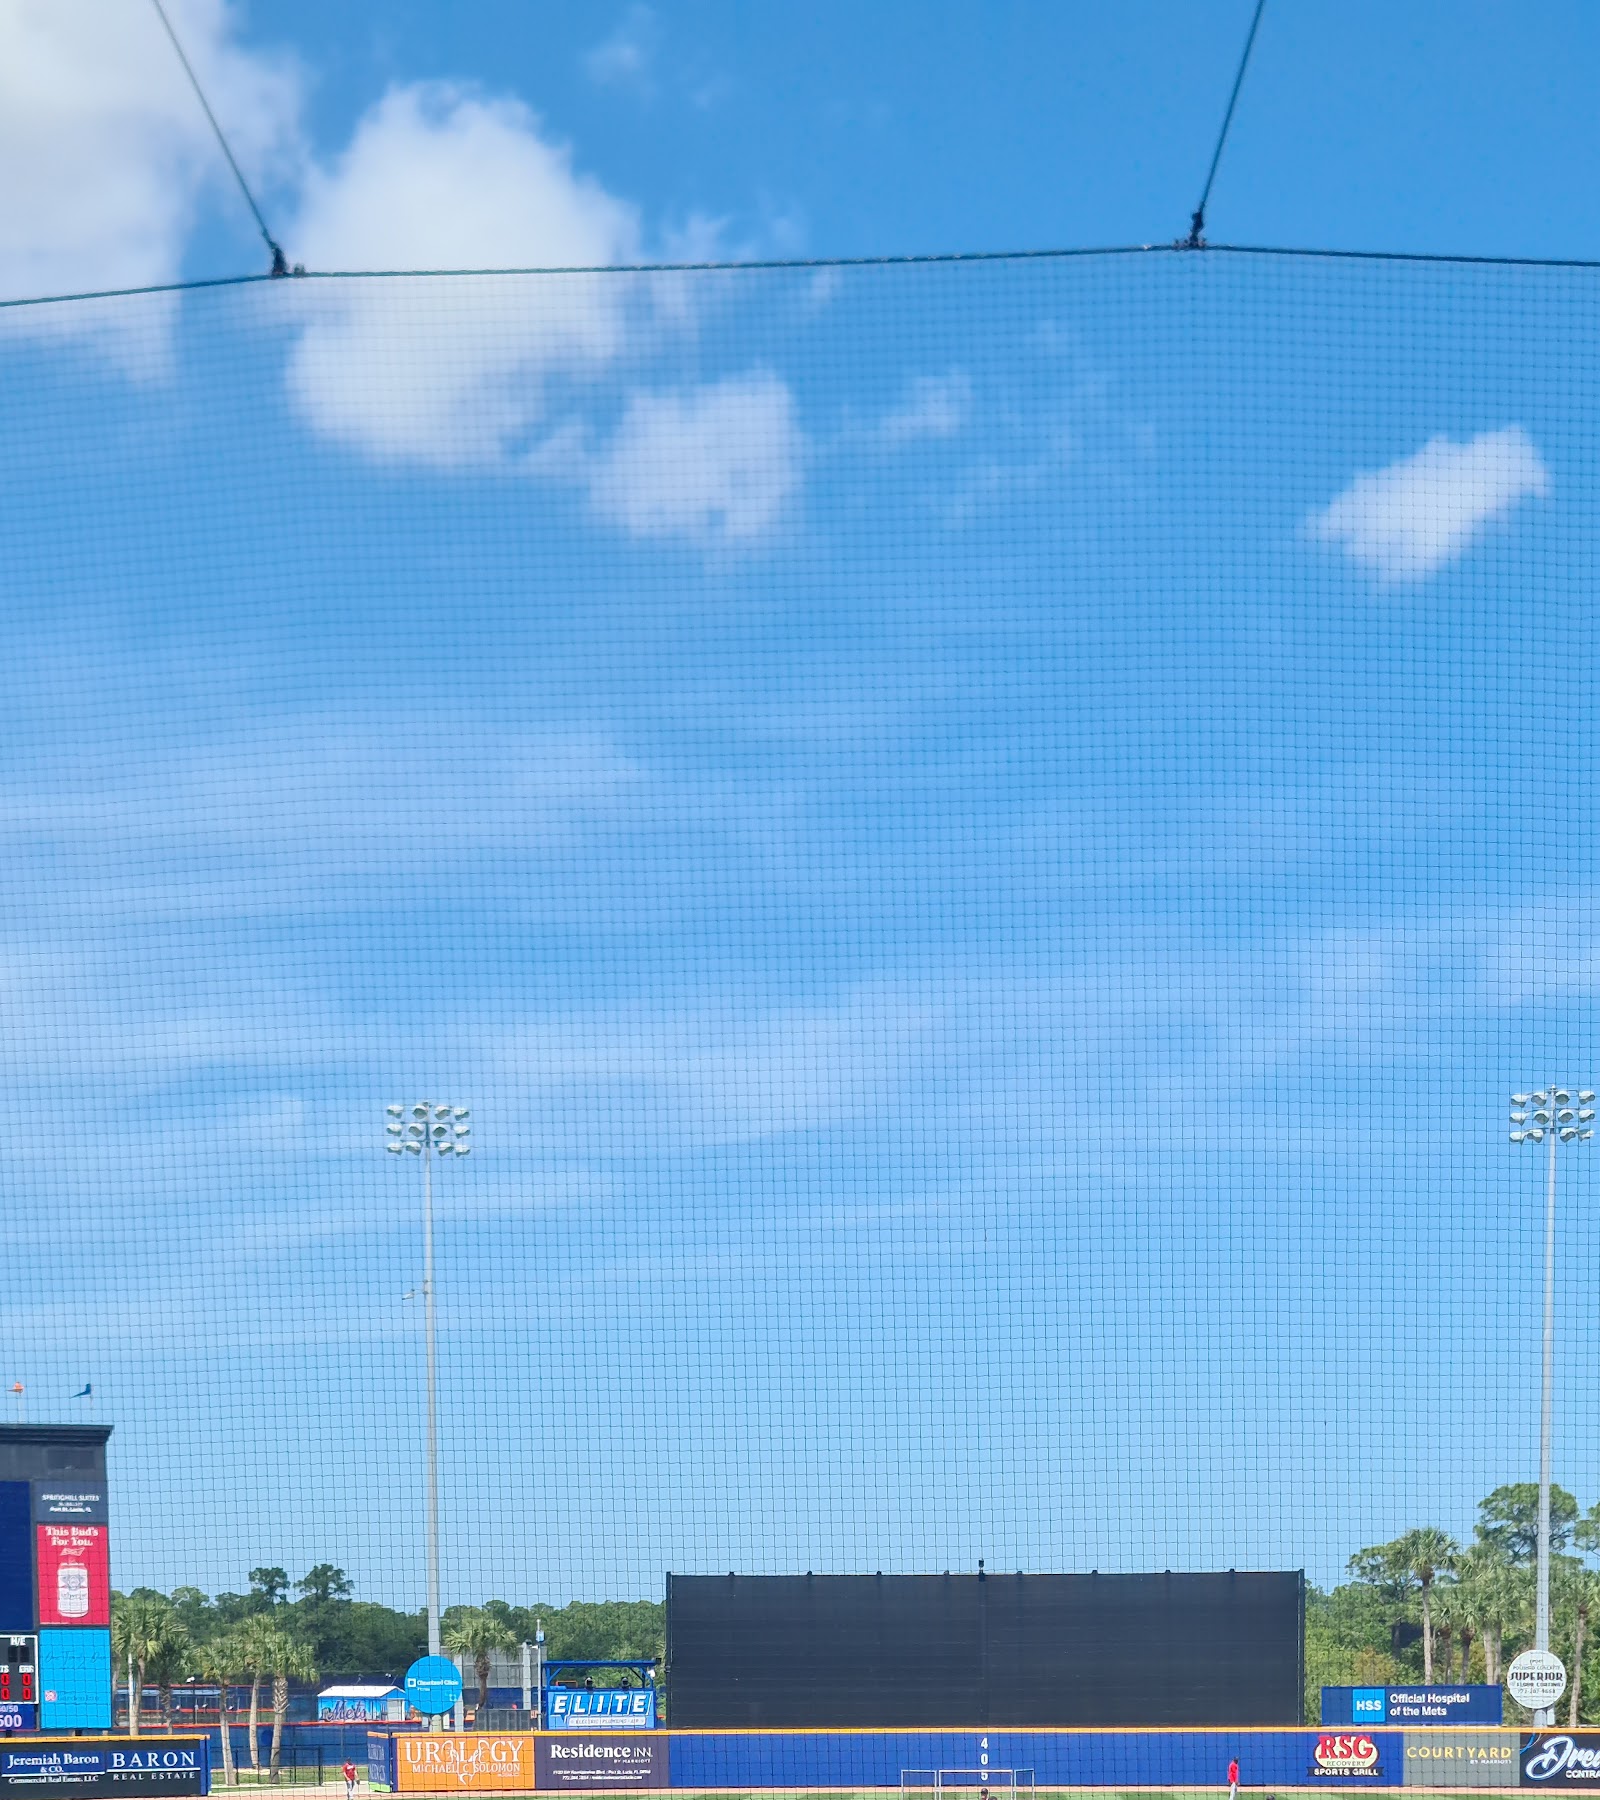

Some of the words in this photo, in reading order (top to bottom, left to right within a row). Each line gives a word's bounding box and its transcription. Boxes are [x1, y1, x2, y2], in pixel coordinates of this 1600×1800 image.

[45, 1526, 69, 1537] This
[71, 1526, 99, 1537] Bud's
[51, 1537, 69, 1547] For
[1510, 1672, 1563, 1681] SUPERIOR
[554, 1695, 646, 1713] ELITE
[1390, 1693, 1425, 1704] Official
[1428, 1693, 1470, 1704] Hospital
[320, 1700, 367, 1721] Mets
[1356, 1701, 1381, 1710] HSS
[1390, 1707, 1401, 1716] of
[1403, 1707, 1419, 1716] the
[1422, 1707, 1446, 1716] Mets
[550, 1744, 630, 1758] Residence
[1318, 1735, 1373, 1760] RSG
[1407, 1746, 1511, 1758] COURTYARD
[7, 1753, 60, 1769] Jeremiah
[63, 1753, 99, 1765] Baron
[112, 1751, 195, 1768] BARON
[980, 1737, 988, 1781] 405
[412, 1763, 458, 1774] MICHAEL
[474, 1763, 520, 1773] SOLOMON
[1314, 1768, 1350, 1776] SPORTS
[1352, 1768, 1379, 1776] GRILL
[8, 1776, 47, 1784] Commercial
[48, 1776, 61, 1784] Real
[84, 1775, 99, 1783] LLC
[113, 1773, 145, 1781] REAL
[151, 1772, 195, 1780] ESTATE
